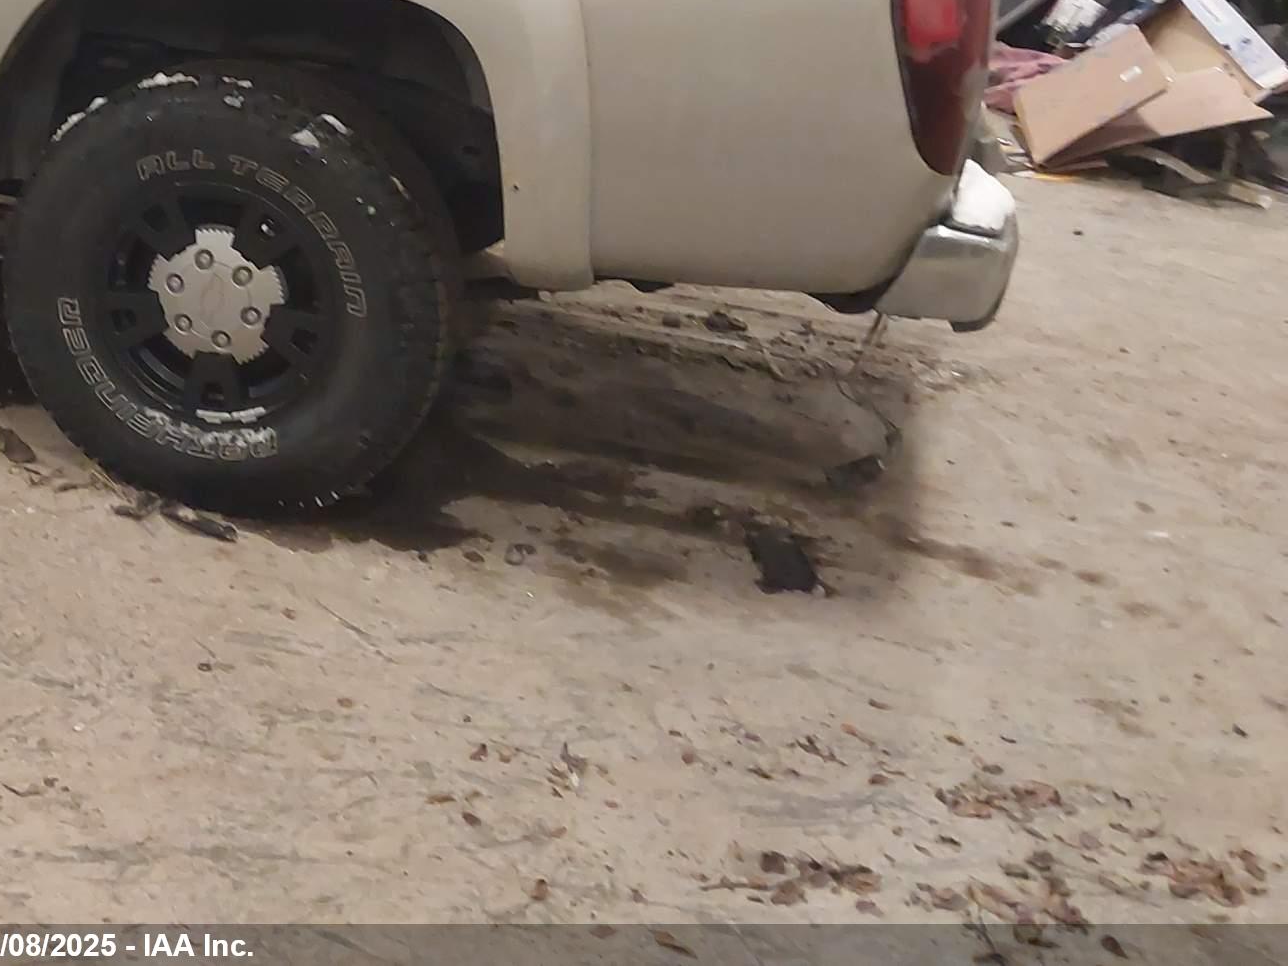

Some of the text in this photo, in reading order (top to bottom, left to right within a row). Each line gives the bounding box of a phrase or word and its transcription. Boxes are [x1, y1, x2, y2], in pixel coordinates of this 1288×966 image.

[136, 149, 368, 318] ALL TERRAIN
[57, 297, 279, 461] PATHFINDER
